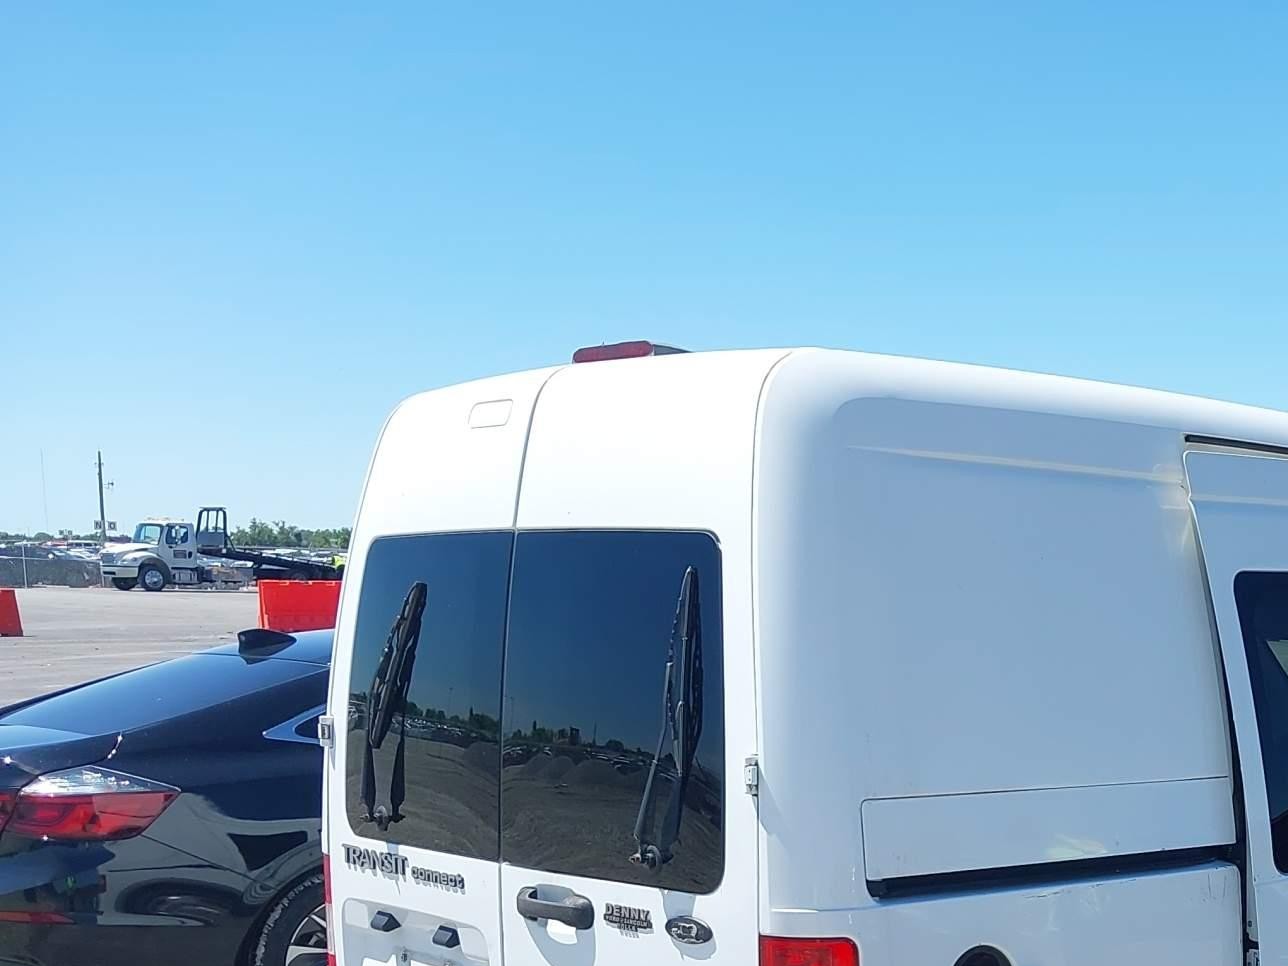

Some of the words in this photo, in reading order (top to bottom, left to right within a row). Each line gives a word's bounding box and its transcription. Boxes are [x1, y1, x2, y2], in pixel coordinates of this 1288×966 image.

[342, 844, 408, 876] TRANSIT
[411, 866, 465, 889] connect
[605, 903, 650, 920] DENNY
